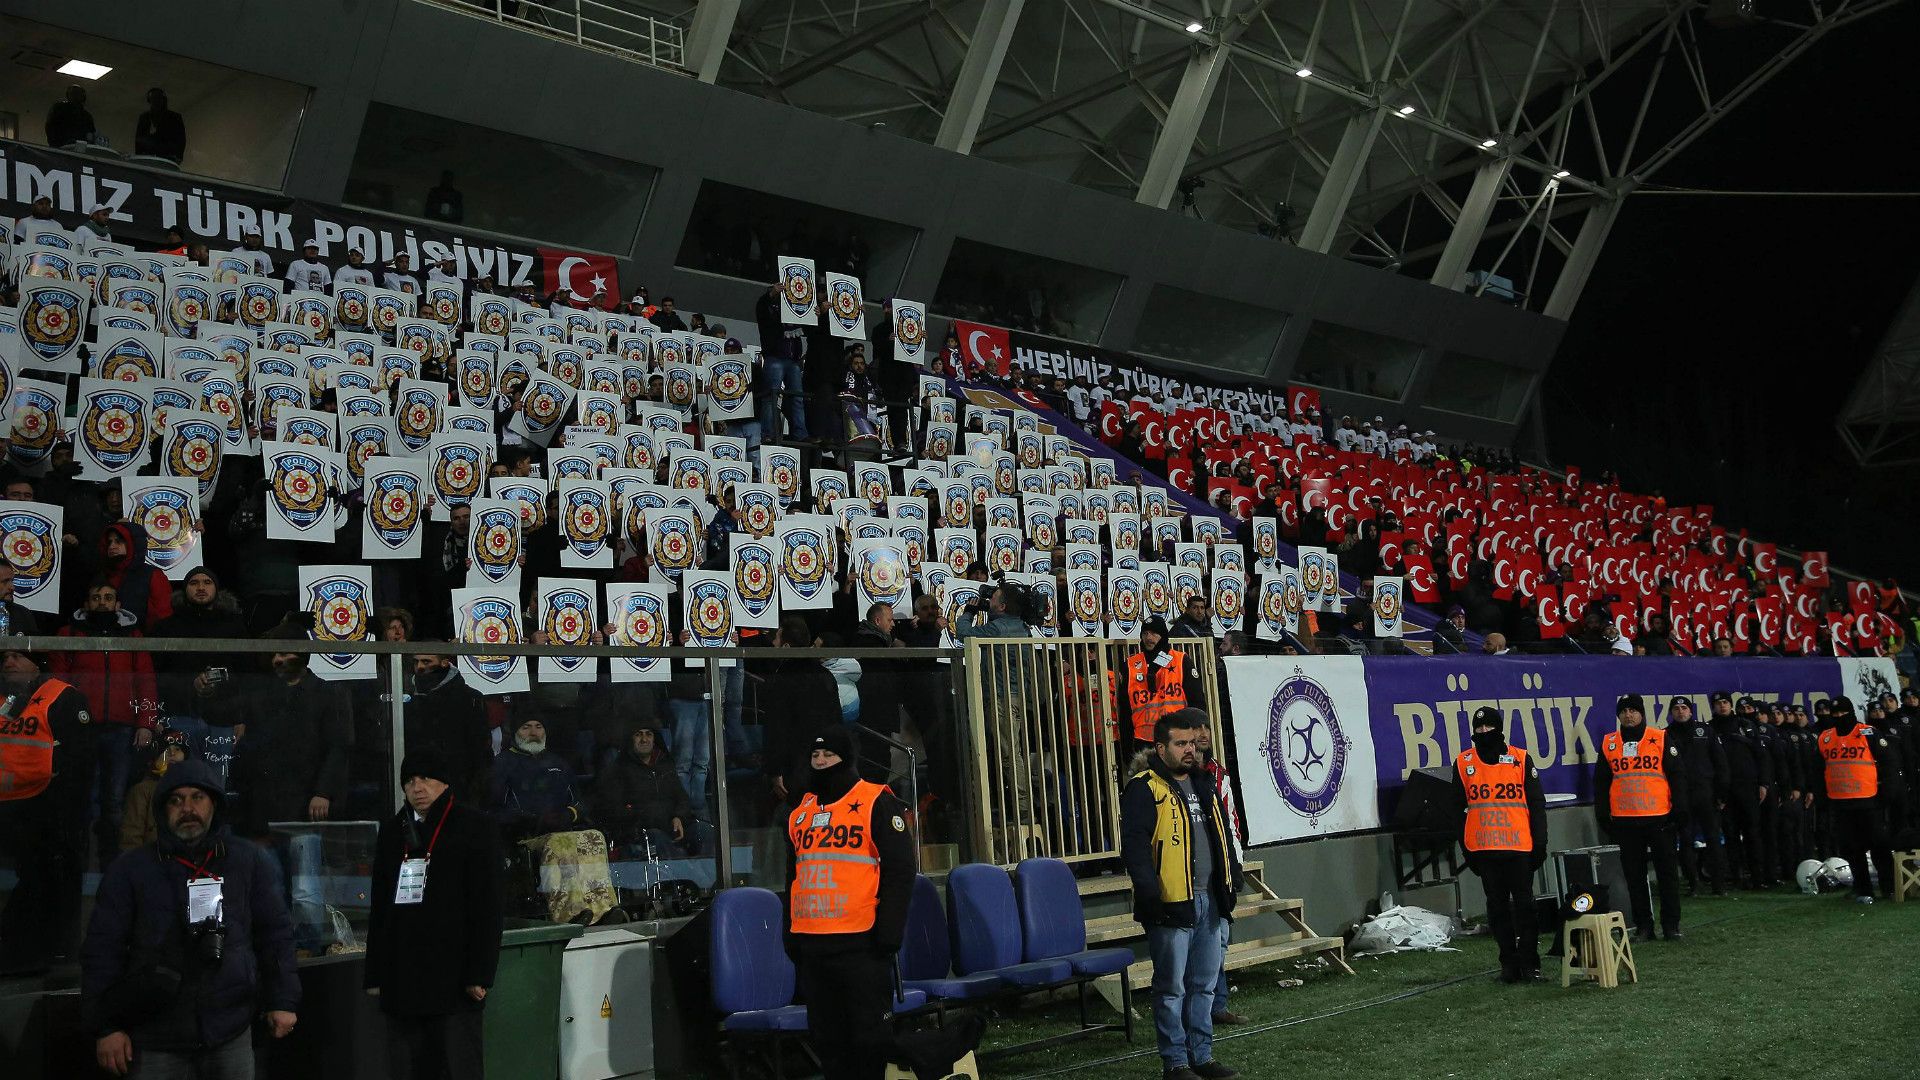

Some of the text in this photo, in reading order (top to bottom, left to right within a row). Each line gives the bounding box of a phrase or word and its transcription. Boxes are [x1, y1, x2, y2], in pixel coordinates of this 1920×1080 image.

[154, 188, 294, 251] TÜRK
[1016, 347, 1112, 385] HEPİMİZ
[1118, 366, 1177, 399] TÜRK
[1306, 800, 1323, 811] 2014
